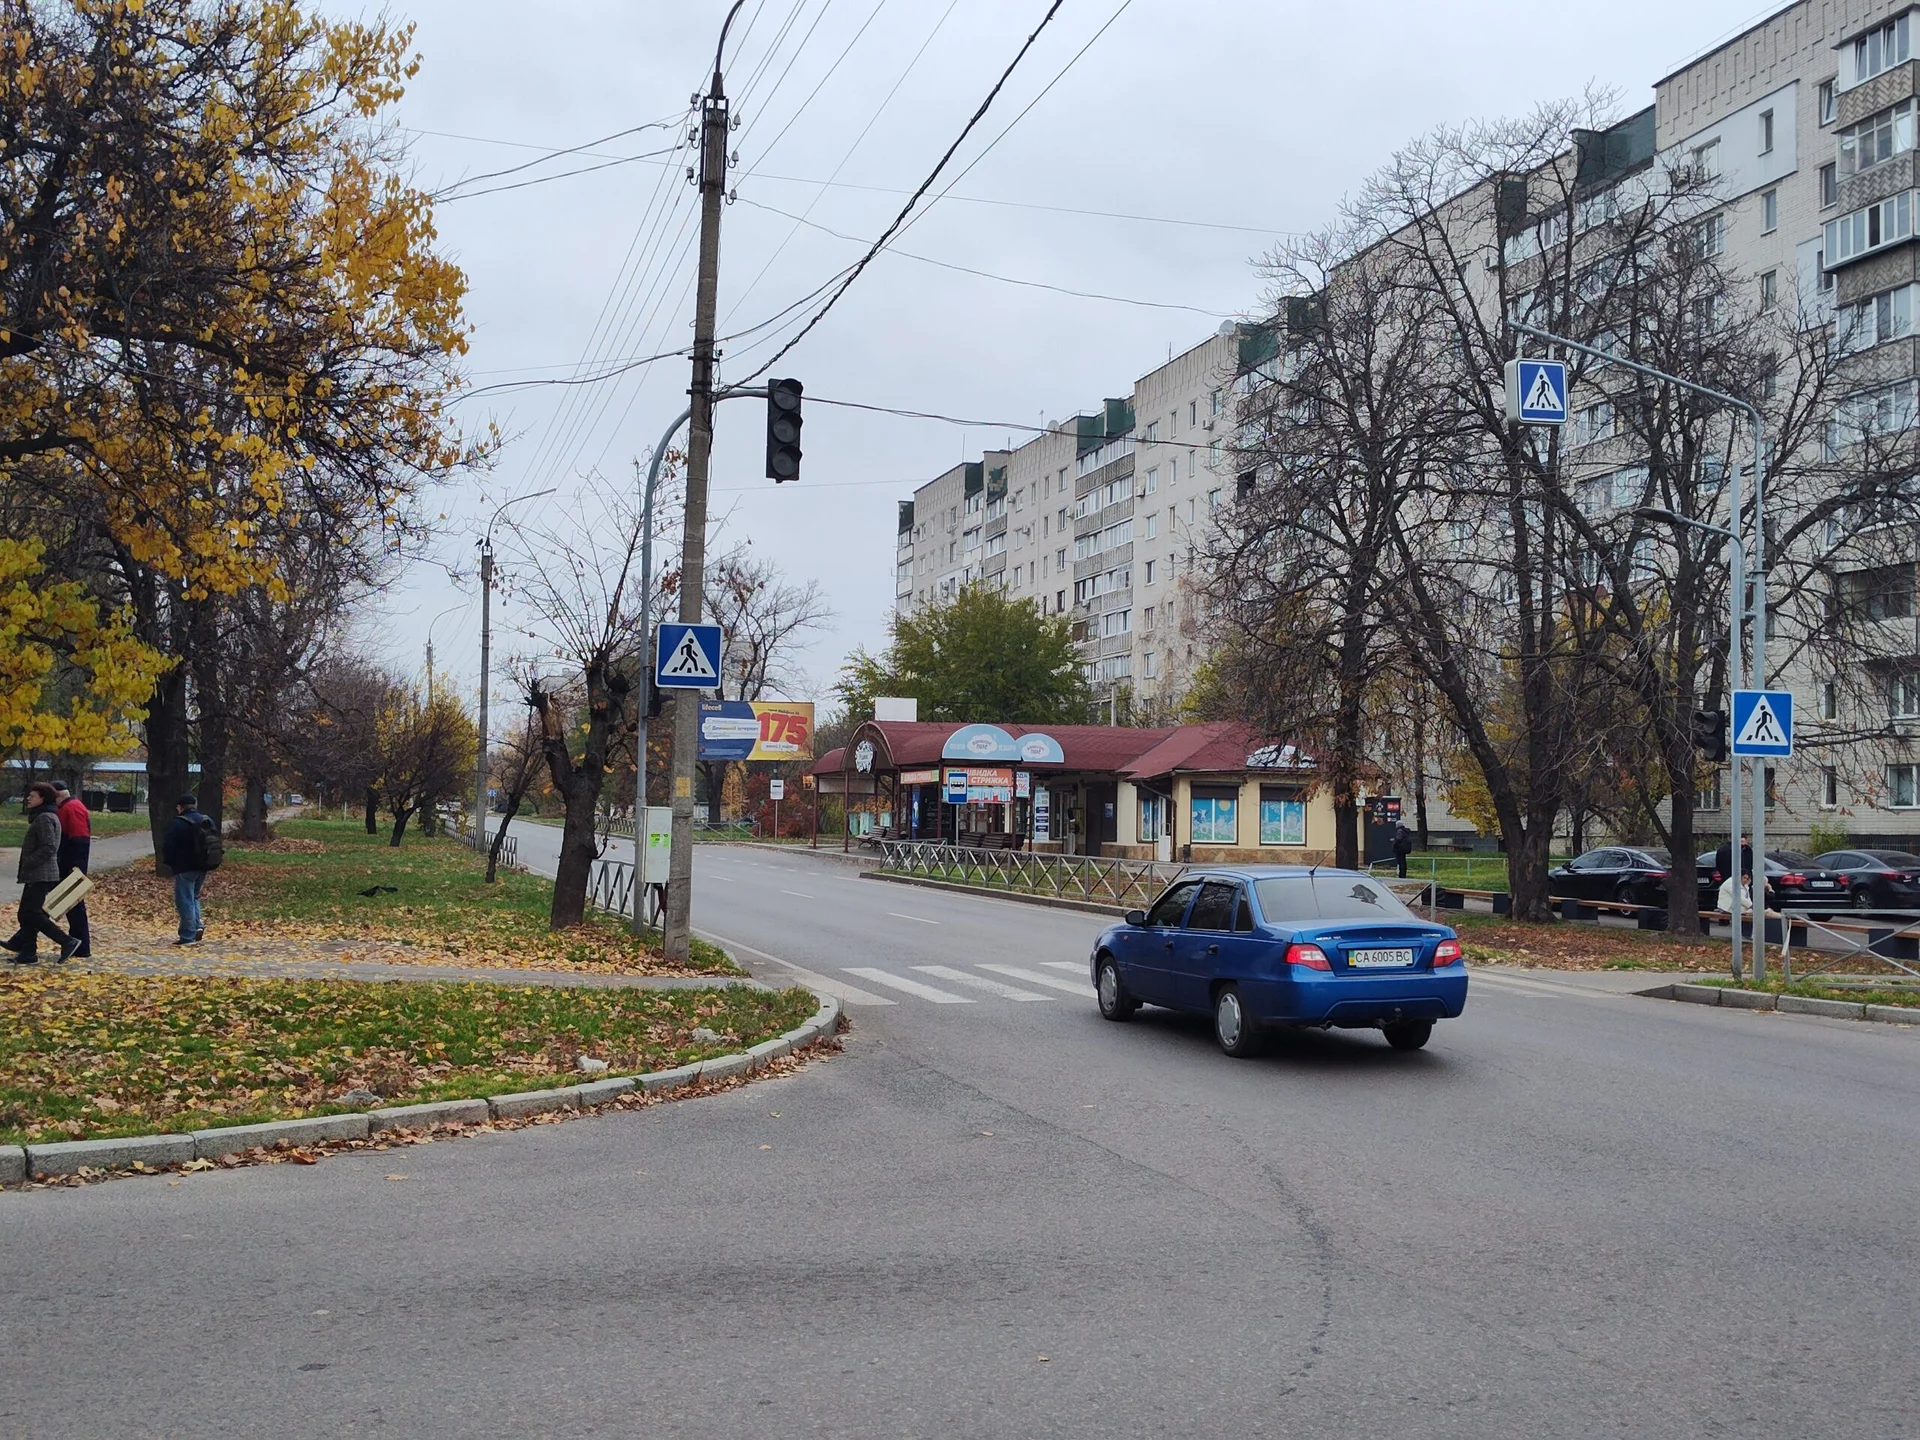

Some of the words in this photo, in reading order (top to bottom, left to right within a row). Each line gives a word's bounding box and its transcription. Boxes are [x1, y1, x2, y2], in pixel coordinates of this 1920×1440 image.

[757, 711, 808, 745] 175
[971, 776, 1009, 784] СТРИЖКА
[1372, 951, 1393, 962] 6005
[1396, 951, 1410, 962] BC
